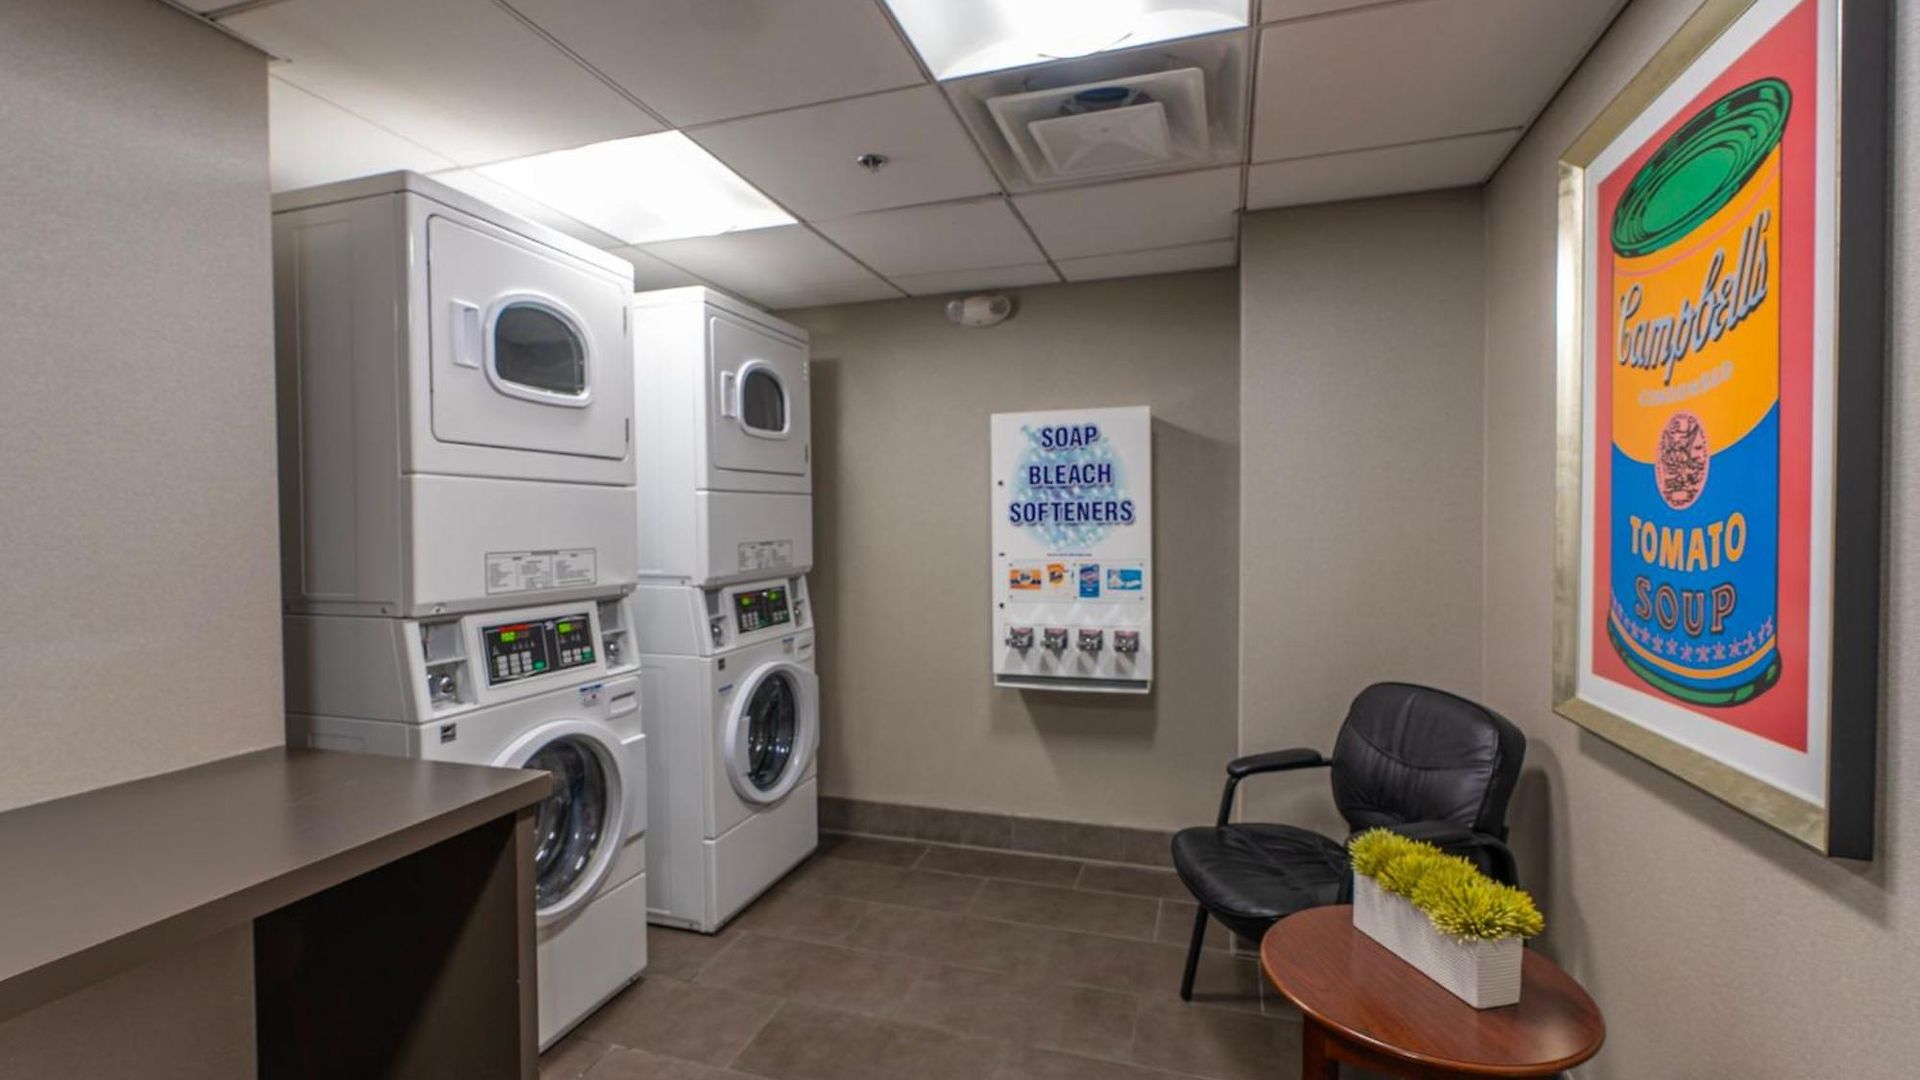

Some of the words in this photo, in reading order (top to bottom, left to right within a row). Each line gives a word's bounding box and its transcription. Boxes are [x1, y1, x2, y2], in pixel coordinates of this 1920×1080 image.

[1041, 426, 1099, 448] SOAP
[1028, 463, 1112, 486] BLEACH
[1009, 500, 1134, 524] SOFTENERS
[1630, 511, 1746, 572] TOMATO
[1635, 576, 1737, 637] SOUP
